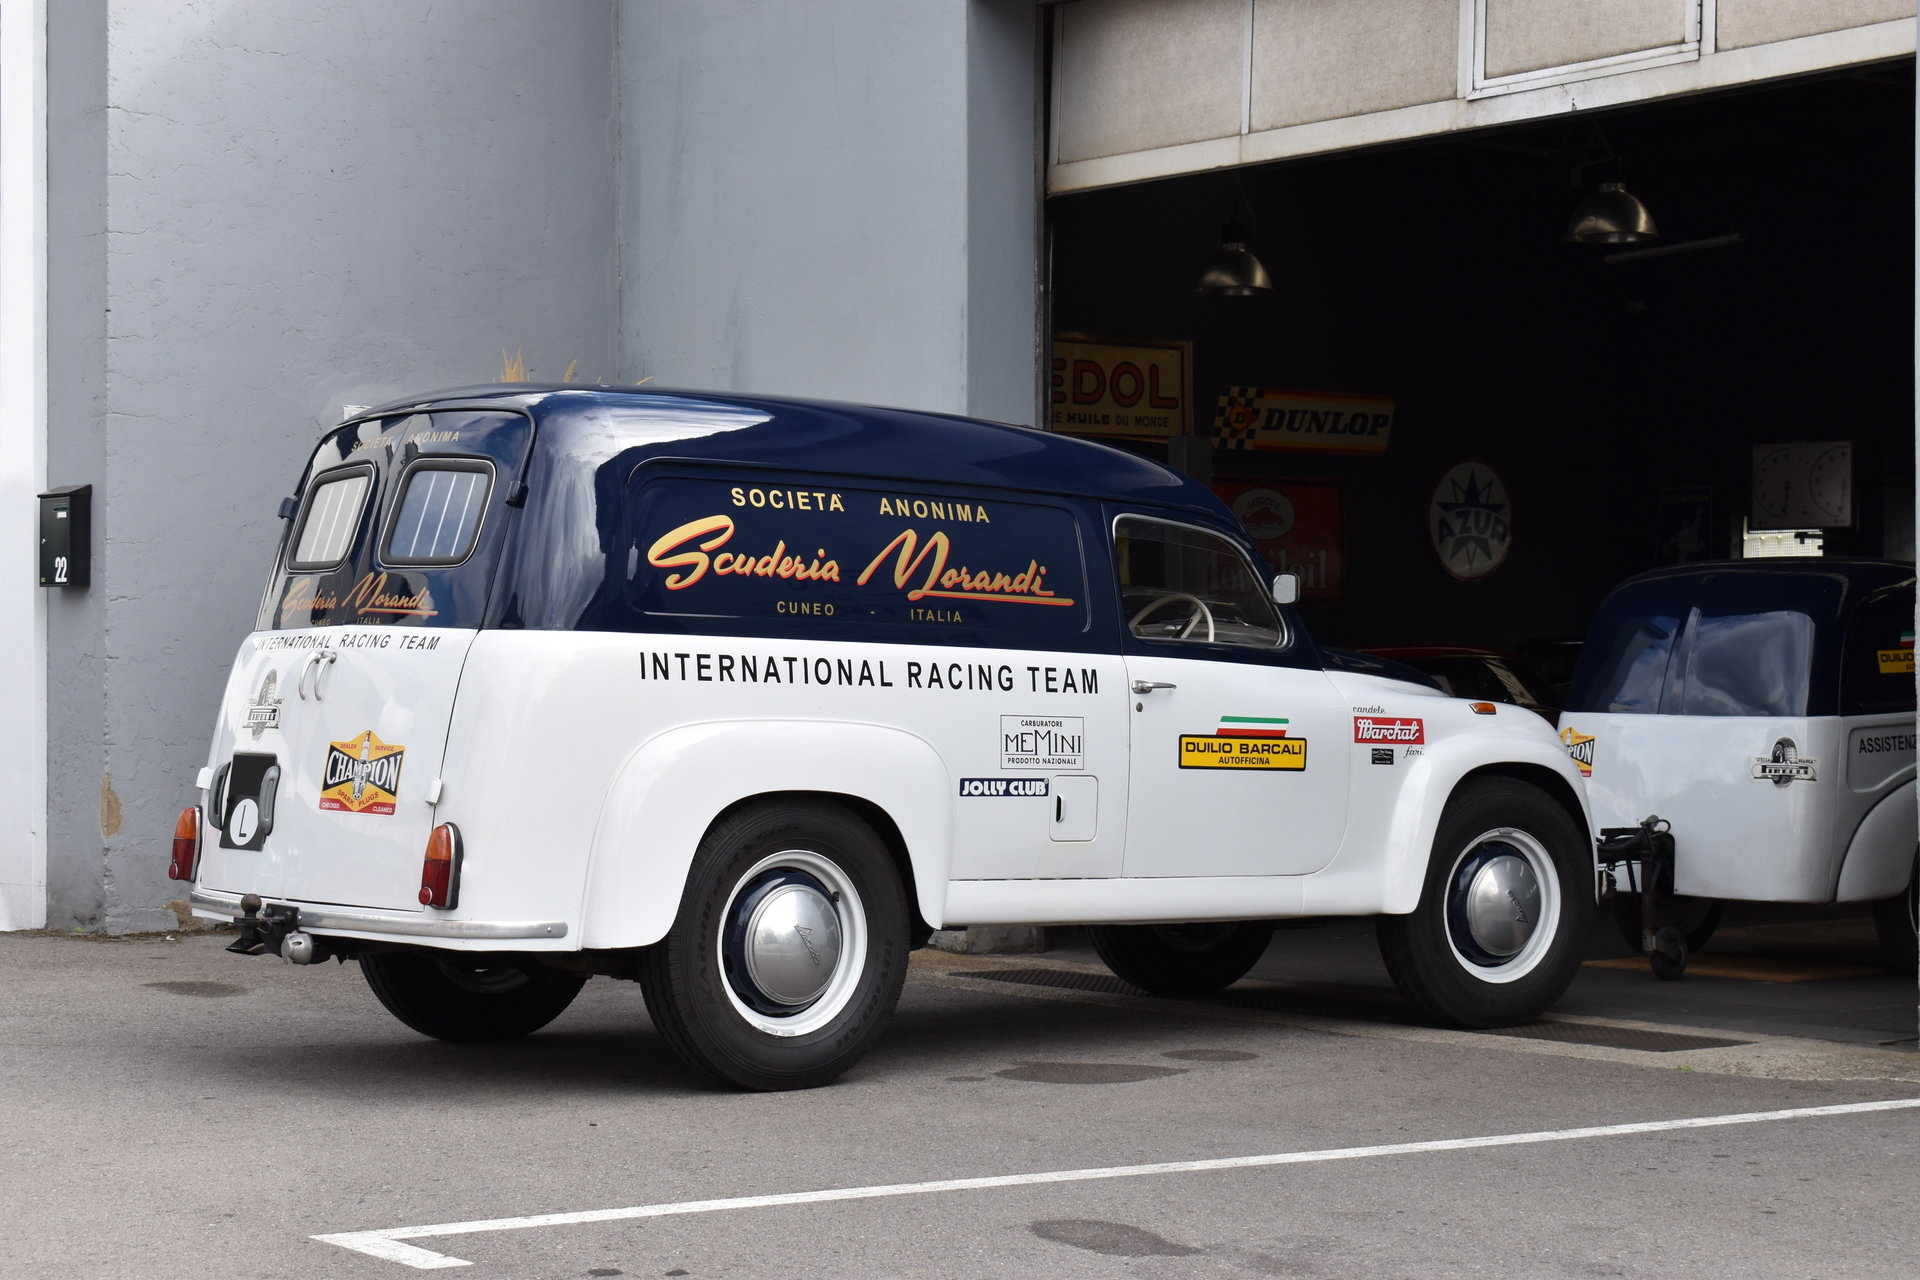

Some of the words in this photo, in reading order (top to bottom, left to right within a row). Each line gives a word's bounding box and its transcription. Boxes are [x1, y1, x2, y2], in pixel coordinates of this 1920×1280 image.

[1067, 412, 1110, 425] HUILE
[1116, 414, 1129, 426] DU
[1135, 415, 1169, 428] MONDE
[1262, 408, 1389, 436] DUNLOP
[407, 431, 460, 445] ANONIMA
[879, 497, 991, 524] ANONIMA
[1438, 509, 1507, 545] AZUR
[54, 556, 68, 583] 22
[647, 514, 840, 591] Scuderia
[857, 528, 1074, 606] Morandi
[282, 577, 337, 622] Scuderia
[341, 571, 439, 616] Morandi
[356, 617, 381, 625] ITALIA
[777, 601, 835, 616] CUNEO
[910, 608, 963, 623] ITALIA
[256, 634, 331, 651] INTERNATIONAL
[339, 634, 391, 649] RACING
[400, 635, 441, 650] TEAM
[639, 652, 893, 687] INTERNATIONAL
[907, 661, 1014, 691] RACING
[1027, 666, 1099, 694] TEAM
[1004, 729, 1081, 755] MEMINI
[1185, 741, 1233, 753] DUILIO
[1240, 743, 1302, 755] BARCALI
[326, 751, 402, 792] CHAMPION
[1007, 757, 1040, 765] PRODOTTO
[1218, 756, 1270, 765] AUTOFFICINA
[337, 789, 355, 807] SPARK
[358, 791, 379, 808] PLUGS
[962, 780, 1007, 796] JOLLY
[1009, 780, 1047, 796] CLUB
[373, 805, 393, 813] CLEANED
[238, 804, 247, 838] L
